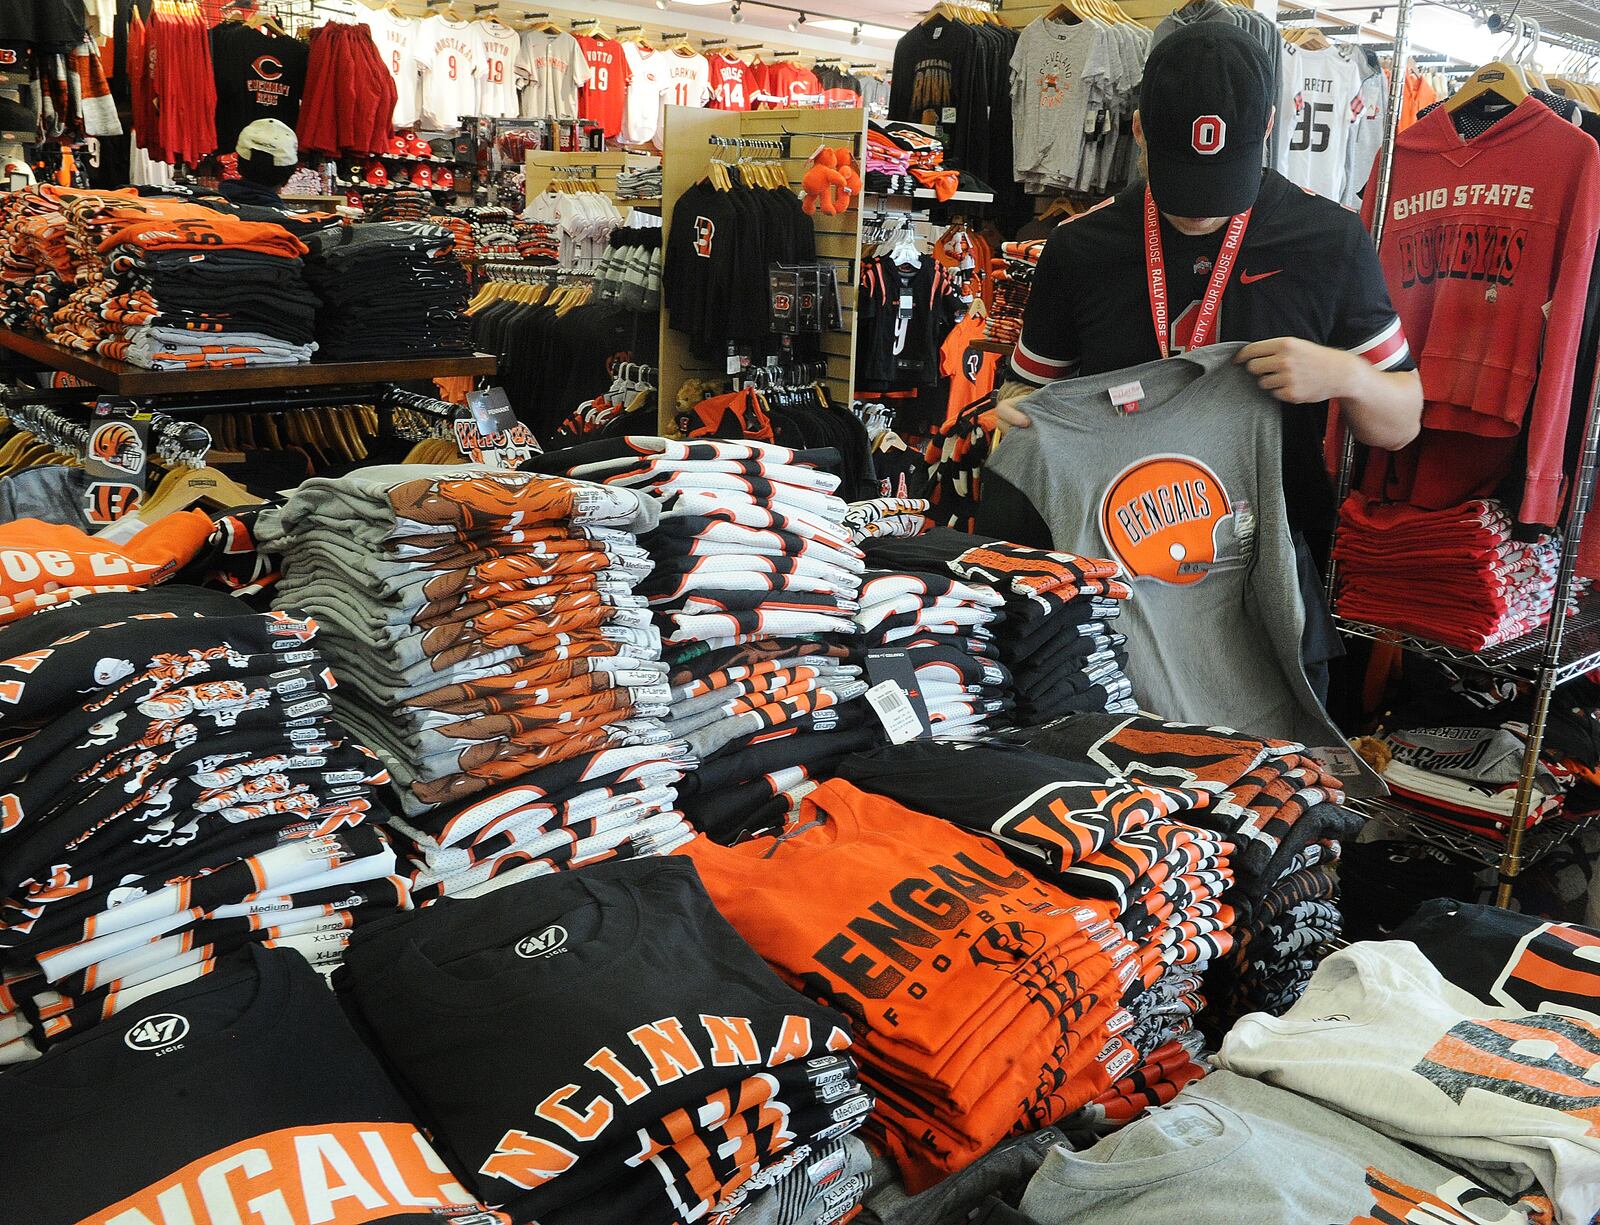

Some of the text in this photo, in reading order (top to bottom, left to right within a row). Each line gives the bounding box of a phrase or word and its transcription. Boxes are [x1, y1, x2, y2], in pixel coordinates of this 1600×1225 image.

[587, 50, 613, 65] VOTTO
[1039, 51, 1072, 80] CLEVELAND
[449, 55, 457, 80] 9
[487, 58, 503, 83] 19
[671, 67, 697, 81] LARKIN
[720, 66, 743, 82] ROSE
[588, 66, 609, 91] 19
[675, 83, 688, 105] 11
[723, 83, 744, 108] 14
[1192, 115, 1226, 154] O
[1394, 188, 1448, 221] OHIO
[1147, 200, 1157, 229] YOUR
[1203, 289, 1220, 316] YOUR
[1226, 217, 1245, 249] RALLY
[1152, 268, 1165, 299] RALLY
[1155, 302, 1167, 337] HOUSE
[1115, 478, 1212, 547] BENGALS
[274, 640, 300, 648] Large
[286, 651, 312, 661] Large
[279, 679, 305, 692] Small
[290, 699, 326, 715] Medium
[292, 730, 317, 739] Small
[289, 758, 324, 767] Medium
[328, 772, 362, 781] Medium
[310, 844, 338, 854] Large
[250, 904, 289, 913] Medium
[333, 897, 360, 908] Large
[316, 922, 343, 932] Large
[314, 931, 351, 943] X-Large
[317, 950, 343, 960] X-Lar
[1107, 1013, 1130, 1030] X-Large
[1096, 1039, 1121, 1062] X-Large
[810, 1057, 837, 1067] Large
[1107, 1051, 1132, 1074] X-Large
[818, 1072, 843, 1086] Large
[825, 1081, 849, 1097] Large
[835, 1099, 869, 1121] Medium
[825, 1177, 858, 1202] X-Large
[818, 1200, 852, 1225] X-Large
